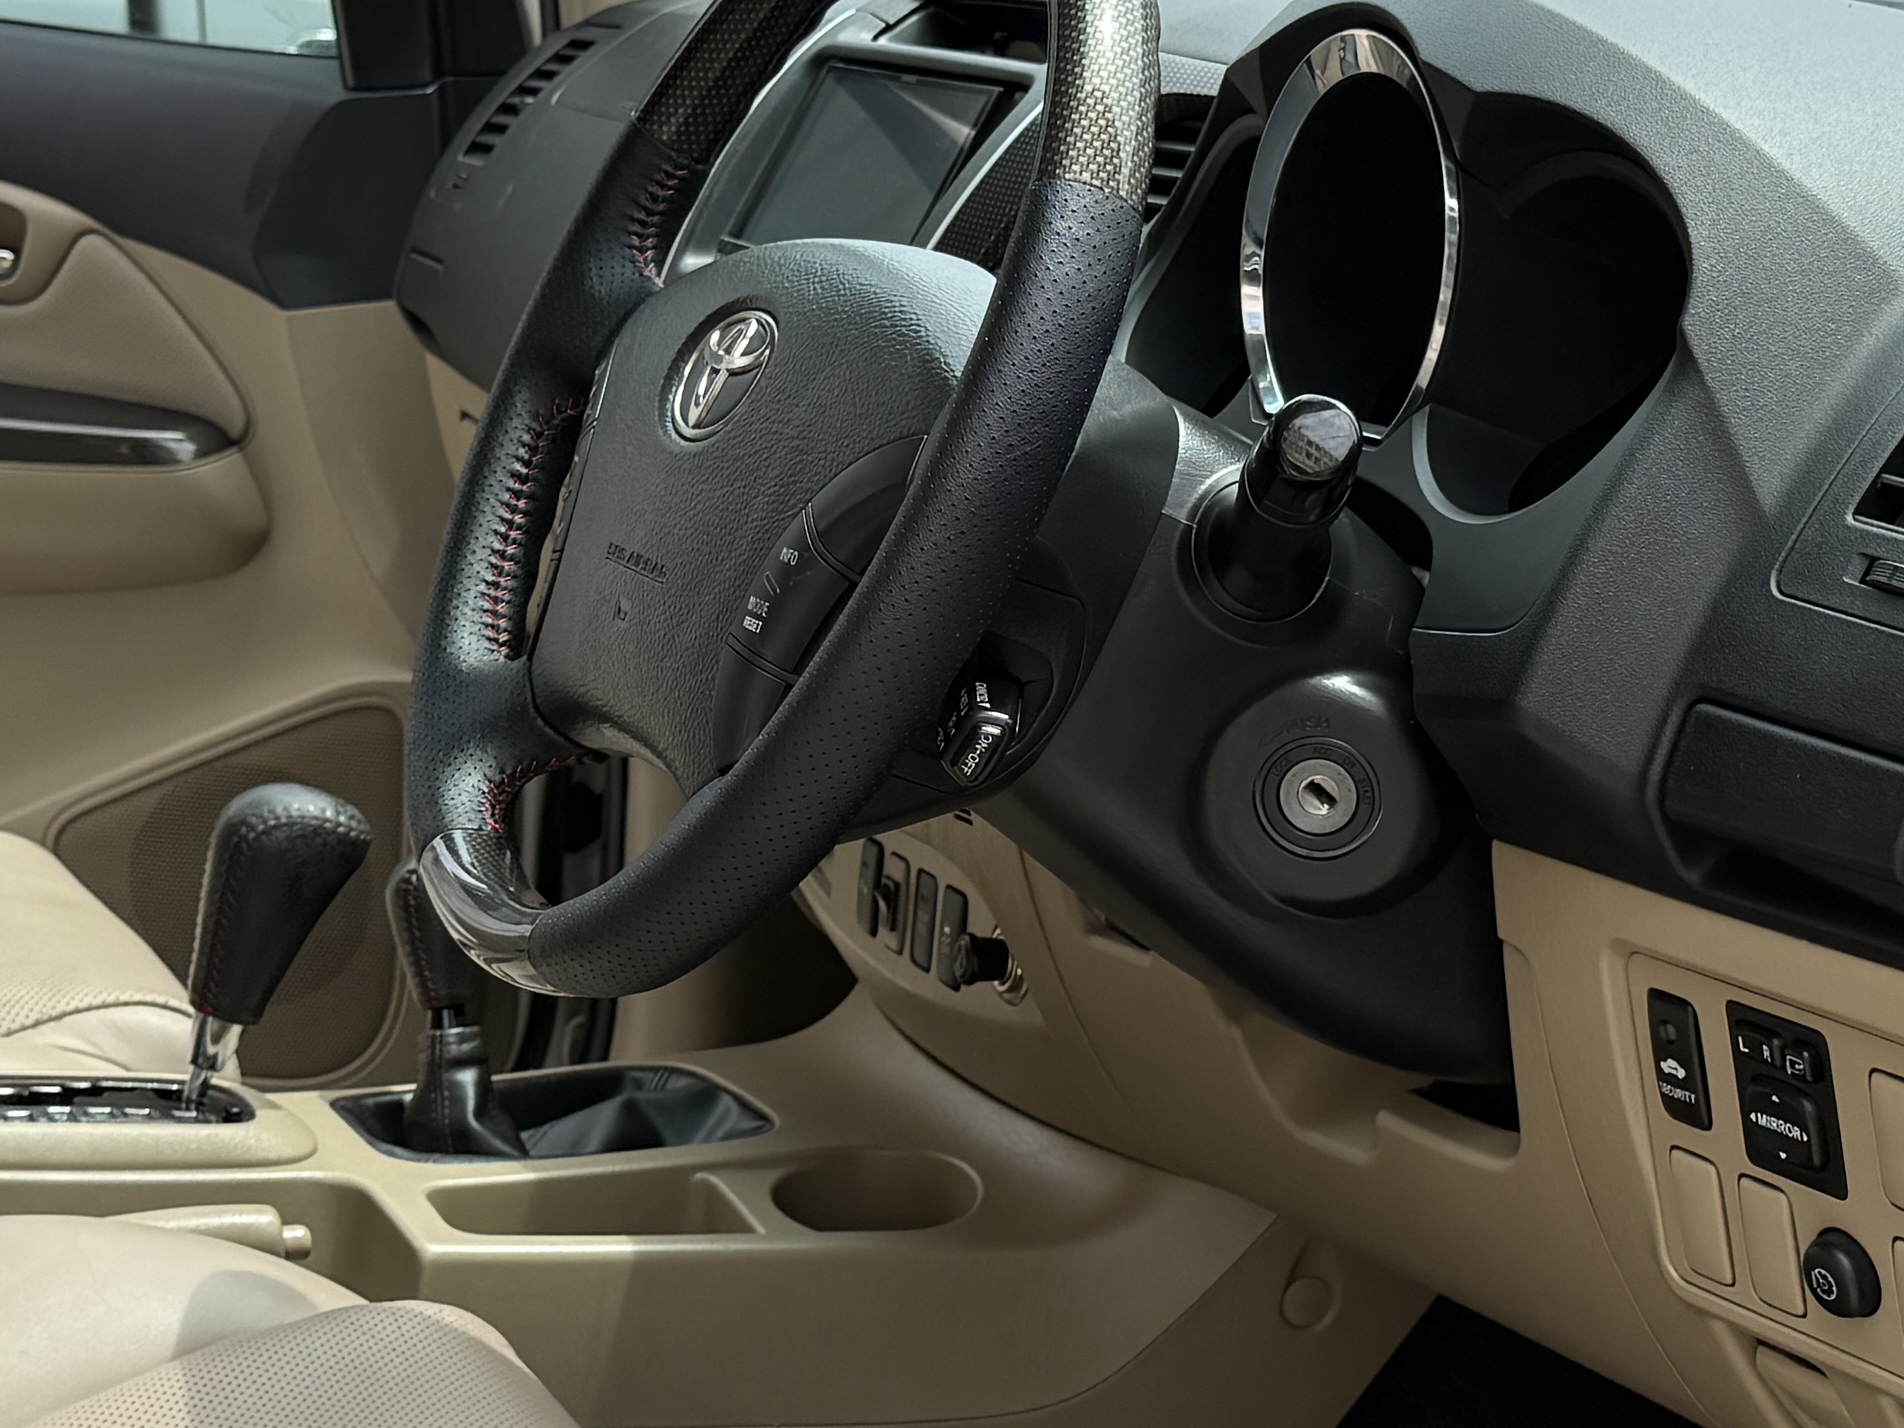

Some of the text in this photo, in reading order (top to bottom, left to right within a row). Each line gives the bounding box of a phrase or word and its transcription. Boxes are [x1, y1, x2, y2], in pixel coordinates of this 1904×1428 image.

[1737, 1036, 1772, 1062] L R
[1757, 1112, 1802, 1141] MIRROR
